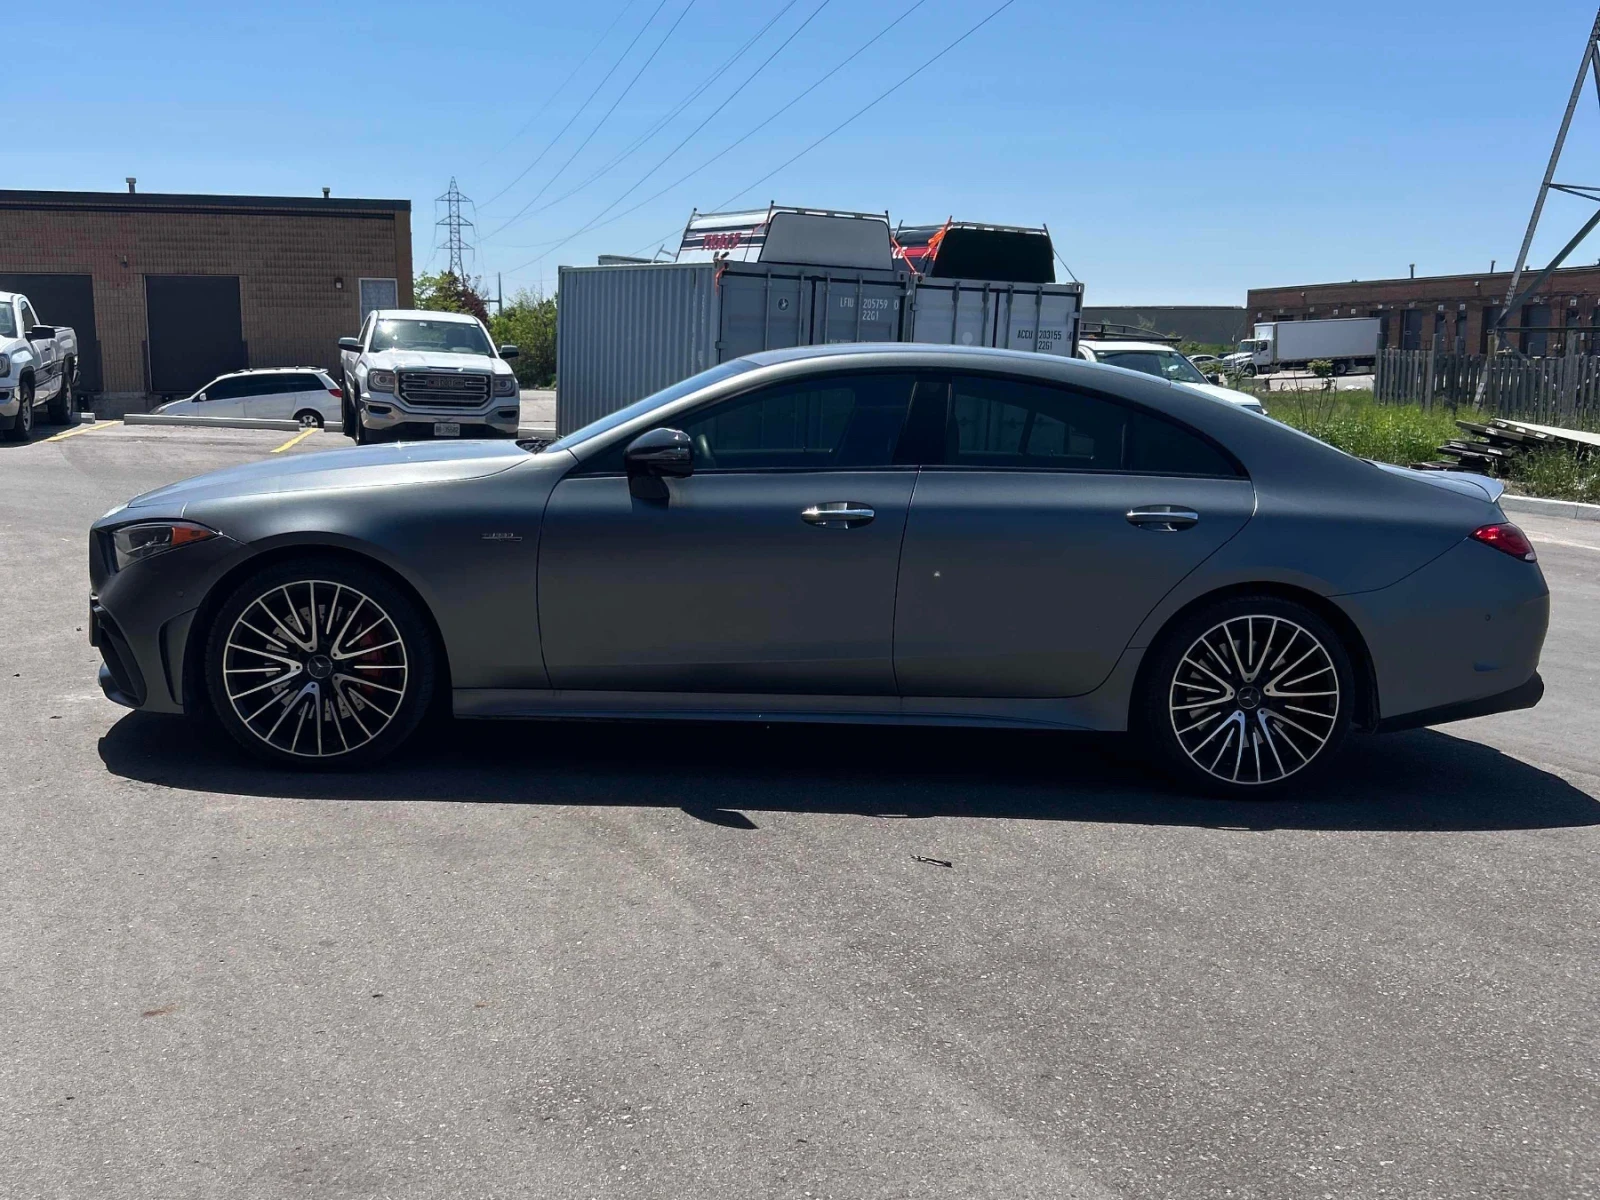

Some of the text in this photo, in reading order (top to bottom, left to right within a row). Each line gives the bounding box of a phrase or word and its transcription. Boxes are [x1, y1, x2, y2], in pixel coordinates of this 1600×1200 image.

[840, 297, 854, 308] LFIU
[863, 299, 888, 310] 205759
[862, 310, 879, 321] 22G1
[1017, 329, 1033, 340] ACCU
[1039, 330, 1062, 341] 203155
[1038, 341, 1053, 350] 22G1
